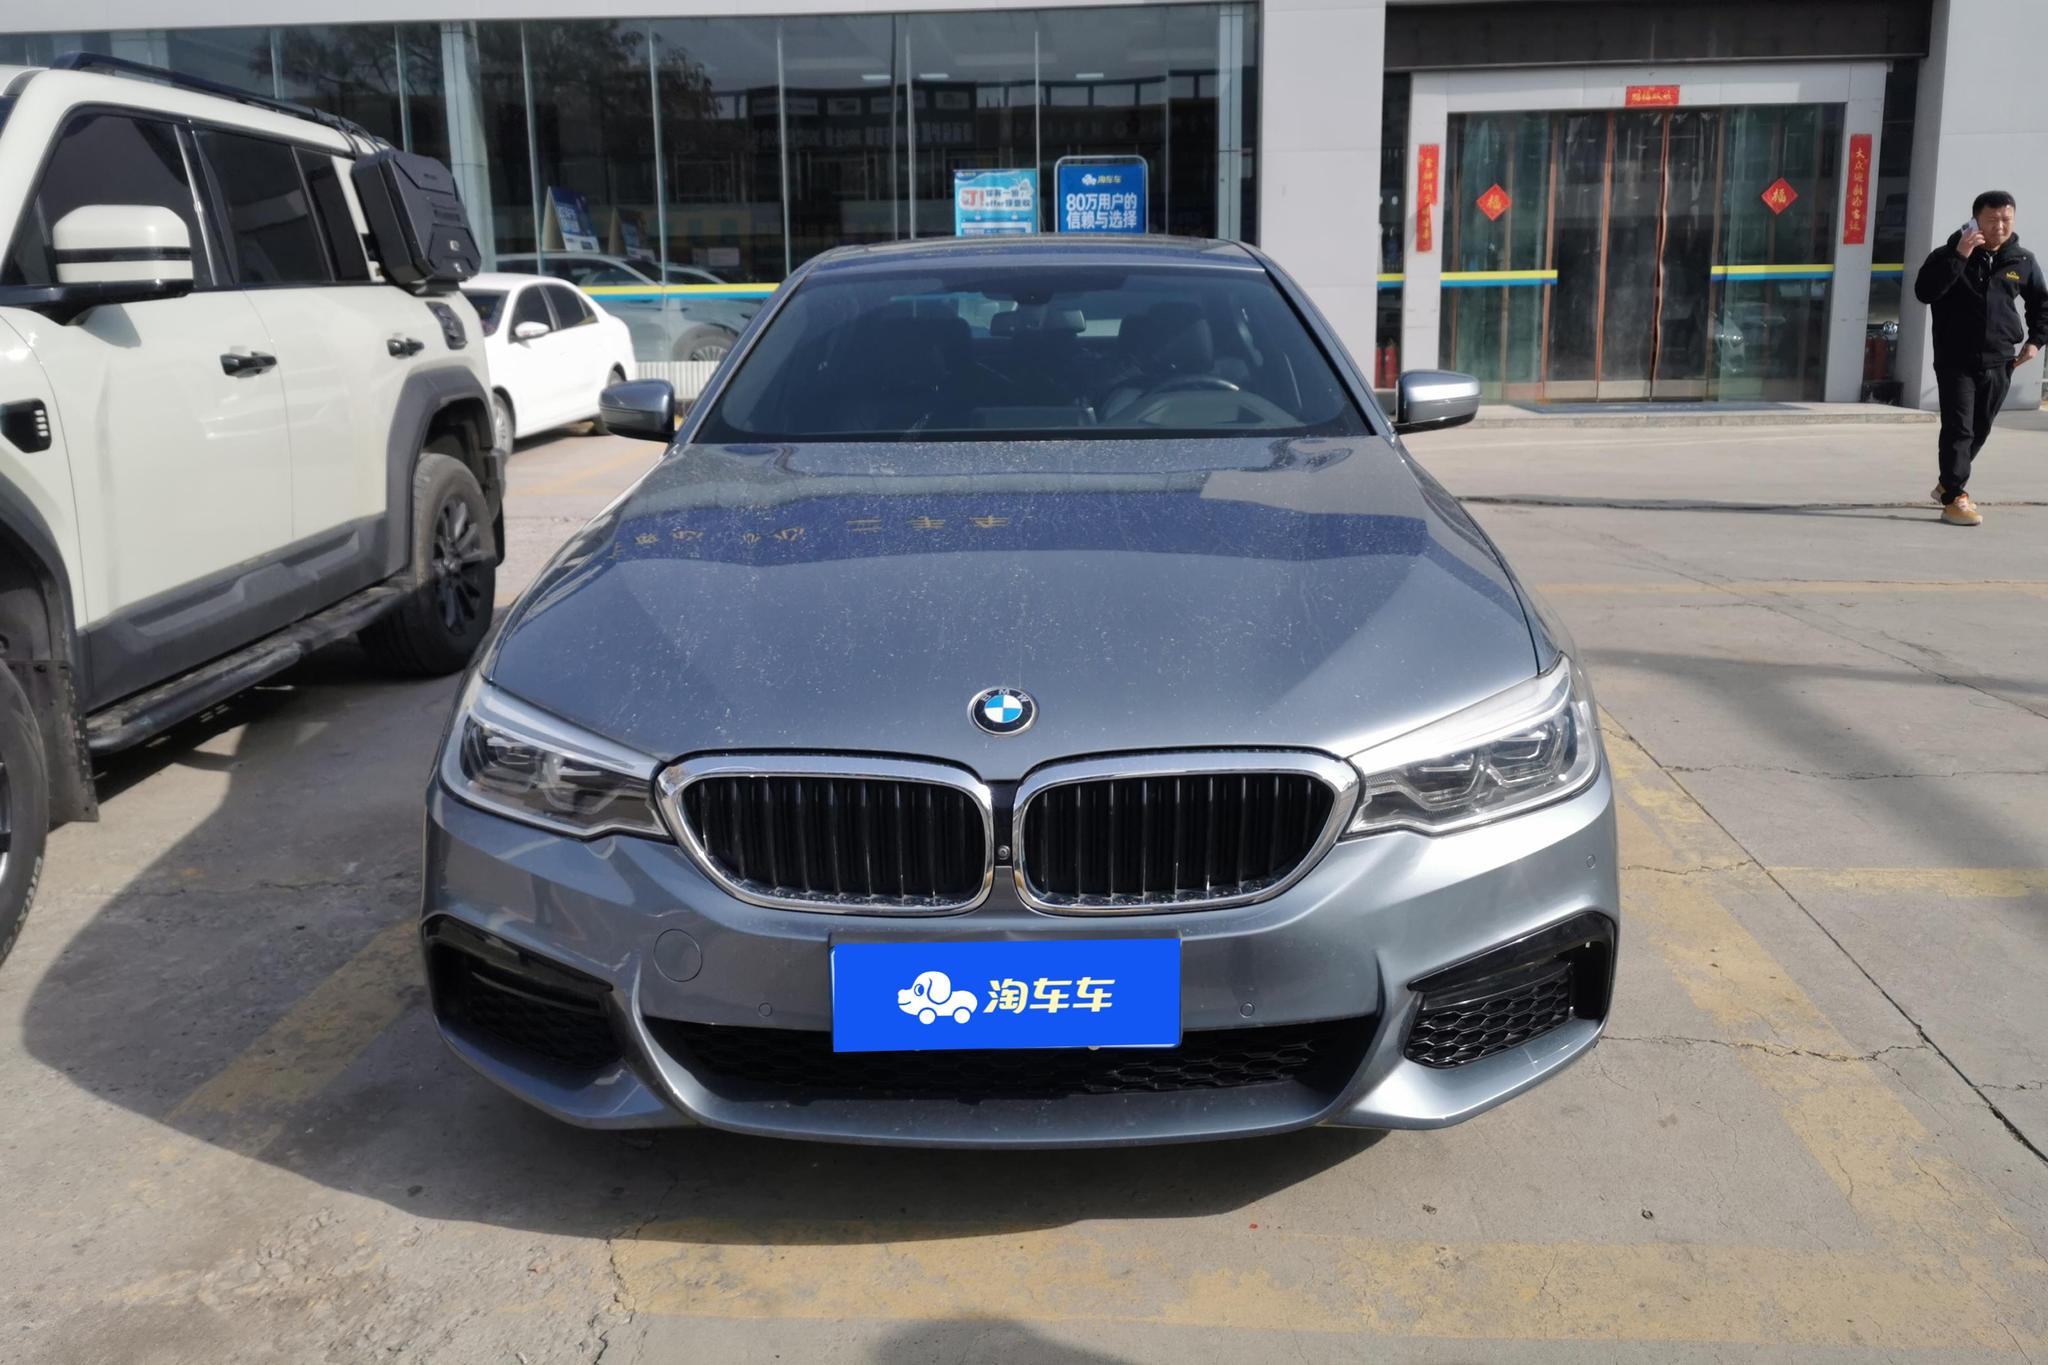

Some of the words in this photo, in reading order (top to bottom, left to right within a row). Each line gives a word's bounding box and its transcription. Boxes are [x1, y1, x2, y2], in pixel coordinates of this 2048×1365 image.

[1066, 192, 1137, 211] 80万用户的
[1772, 187, 1787, 203] 福
[1066, 210, 1137, 229] 信赖与选择
[982, 688, 1029, 702] BMW
